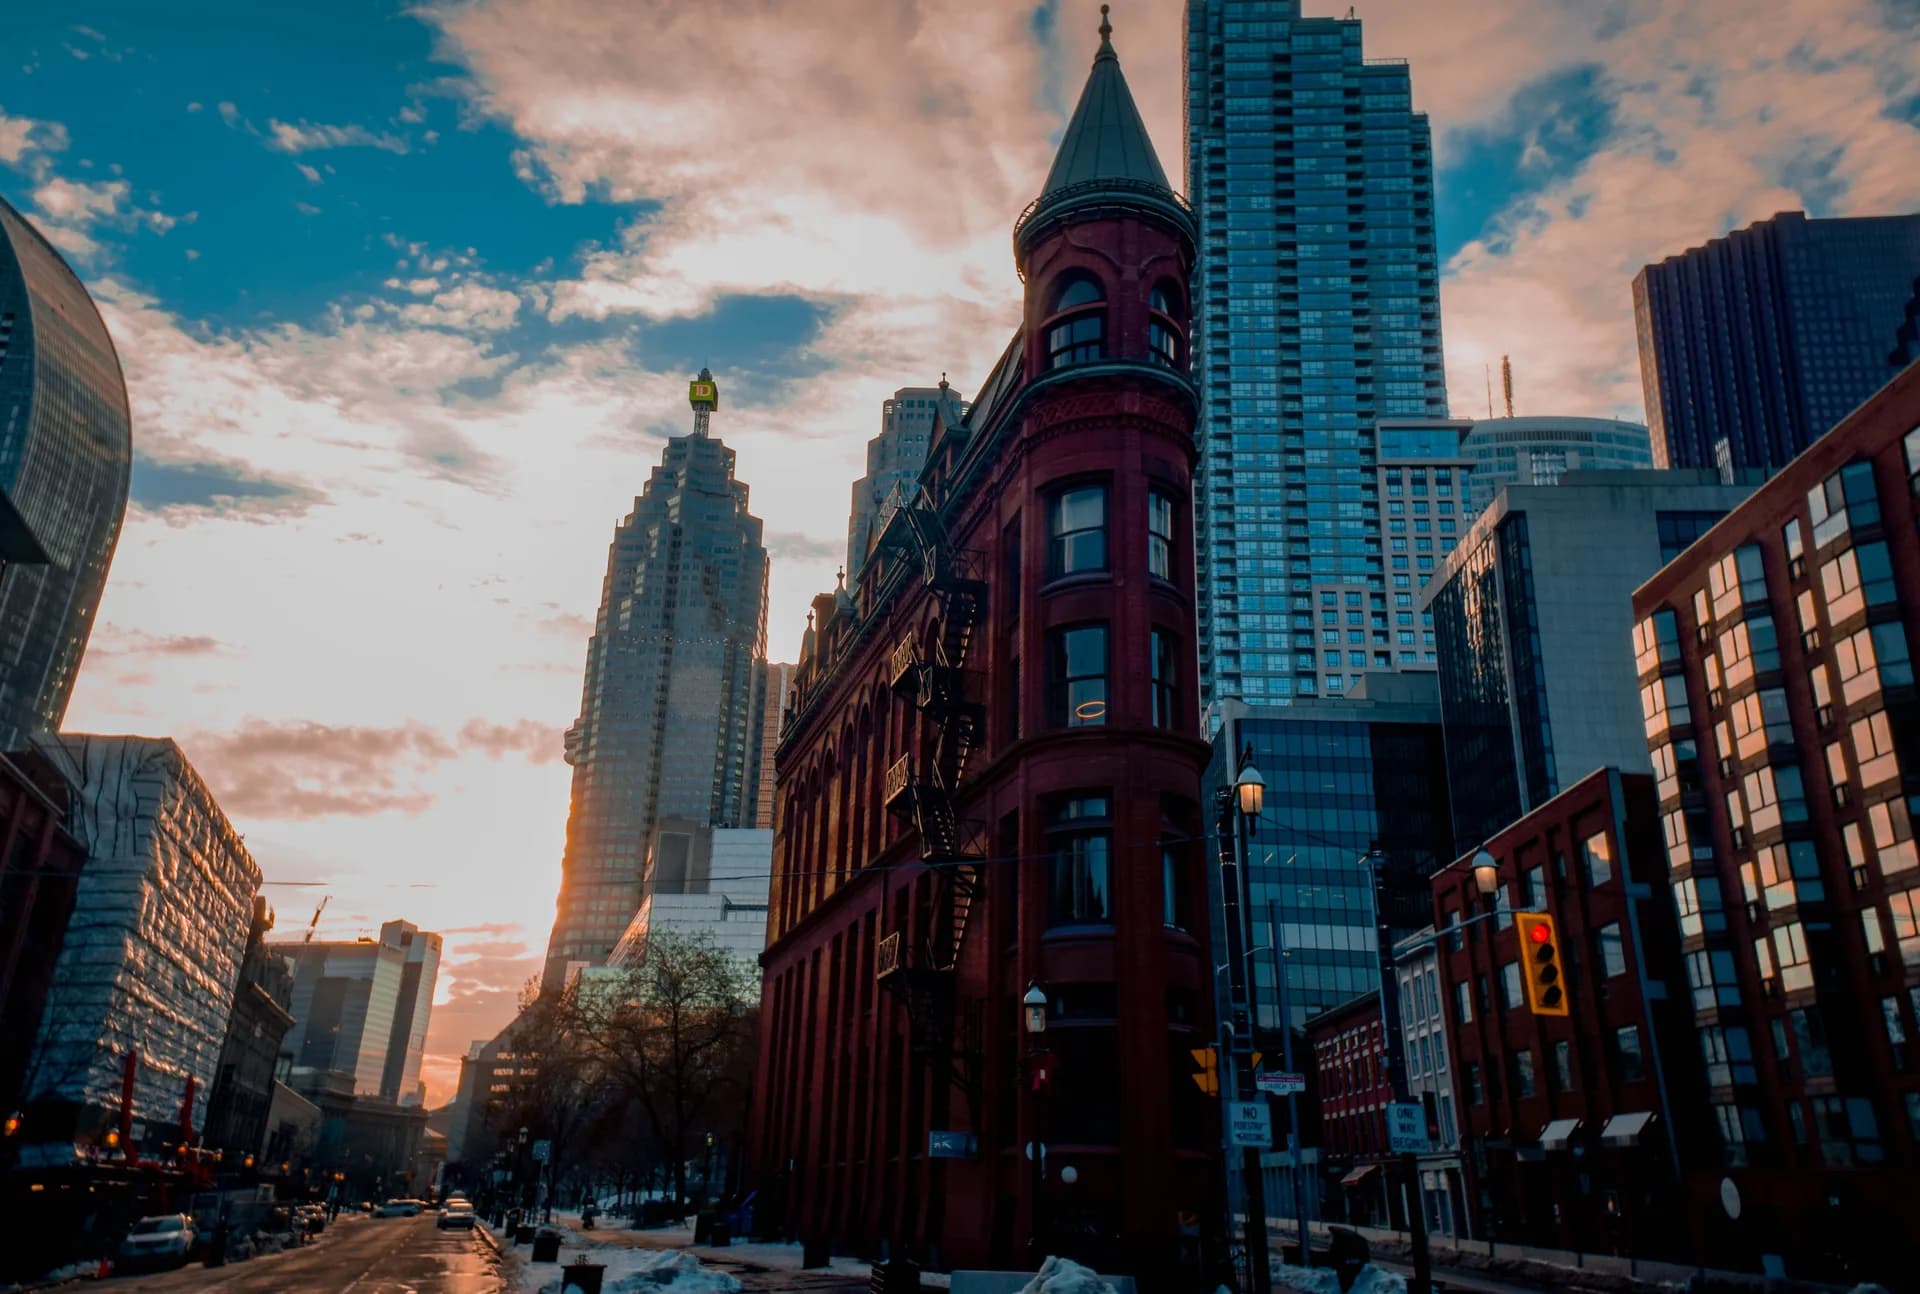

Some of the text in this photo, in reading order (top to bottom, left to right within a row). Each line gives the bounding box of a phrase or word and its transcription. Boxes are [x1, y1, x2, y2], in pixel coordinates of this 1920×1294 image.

[1242, 1106, 1257, 1120] NO
[1397, 1107, 1416, 1120] ONE
[1398, 1122, 1417, 1135] WAY
